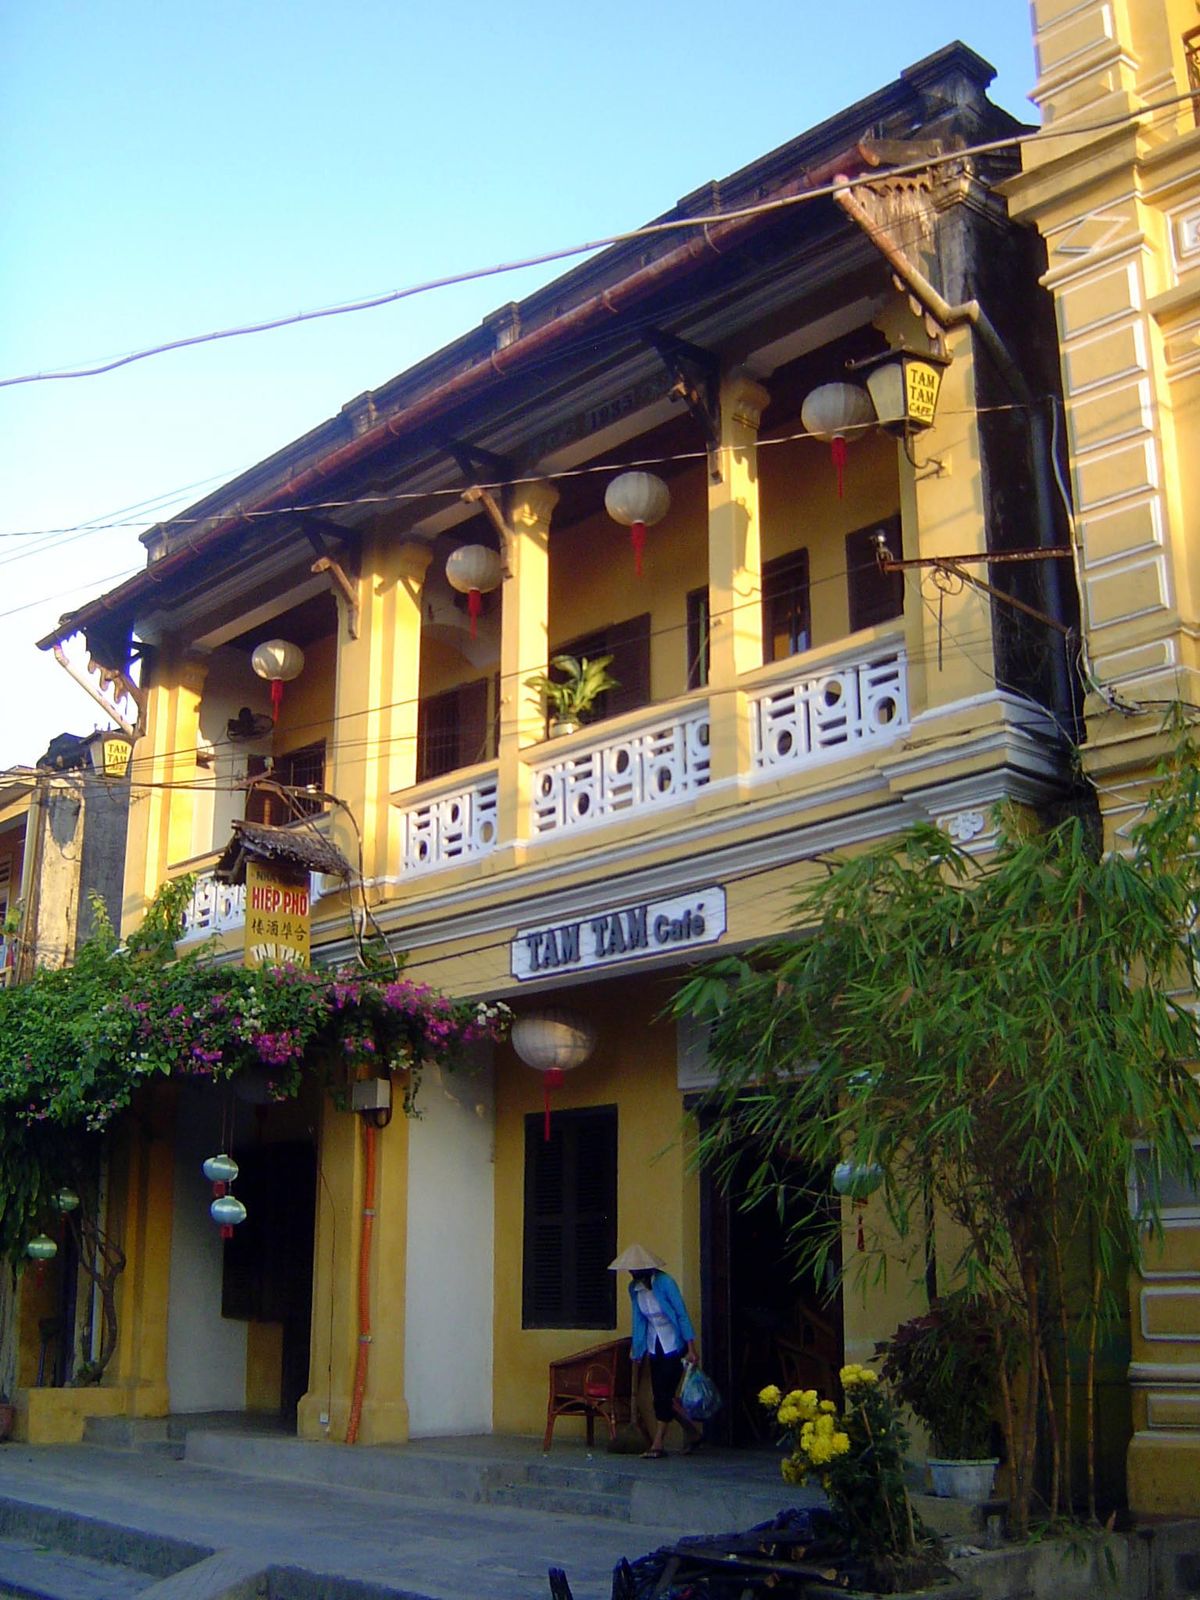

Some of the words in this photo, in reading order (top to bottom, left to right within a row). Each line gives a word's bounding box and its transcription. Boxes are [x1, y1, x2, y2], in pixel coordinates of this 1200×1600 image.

[910, 368, 935, 390] TAM
[909, 385, 934, 406] TAM
[107, 743, 128, 755] TAM
[107, 753, 127, 764] TAM
[525, 924, 581, 972] TAM
[592, 905, 649, 957] TAM
[654, 903, 706, 944] Café
